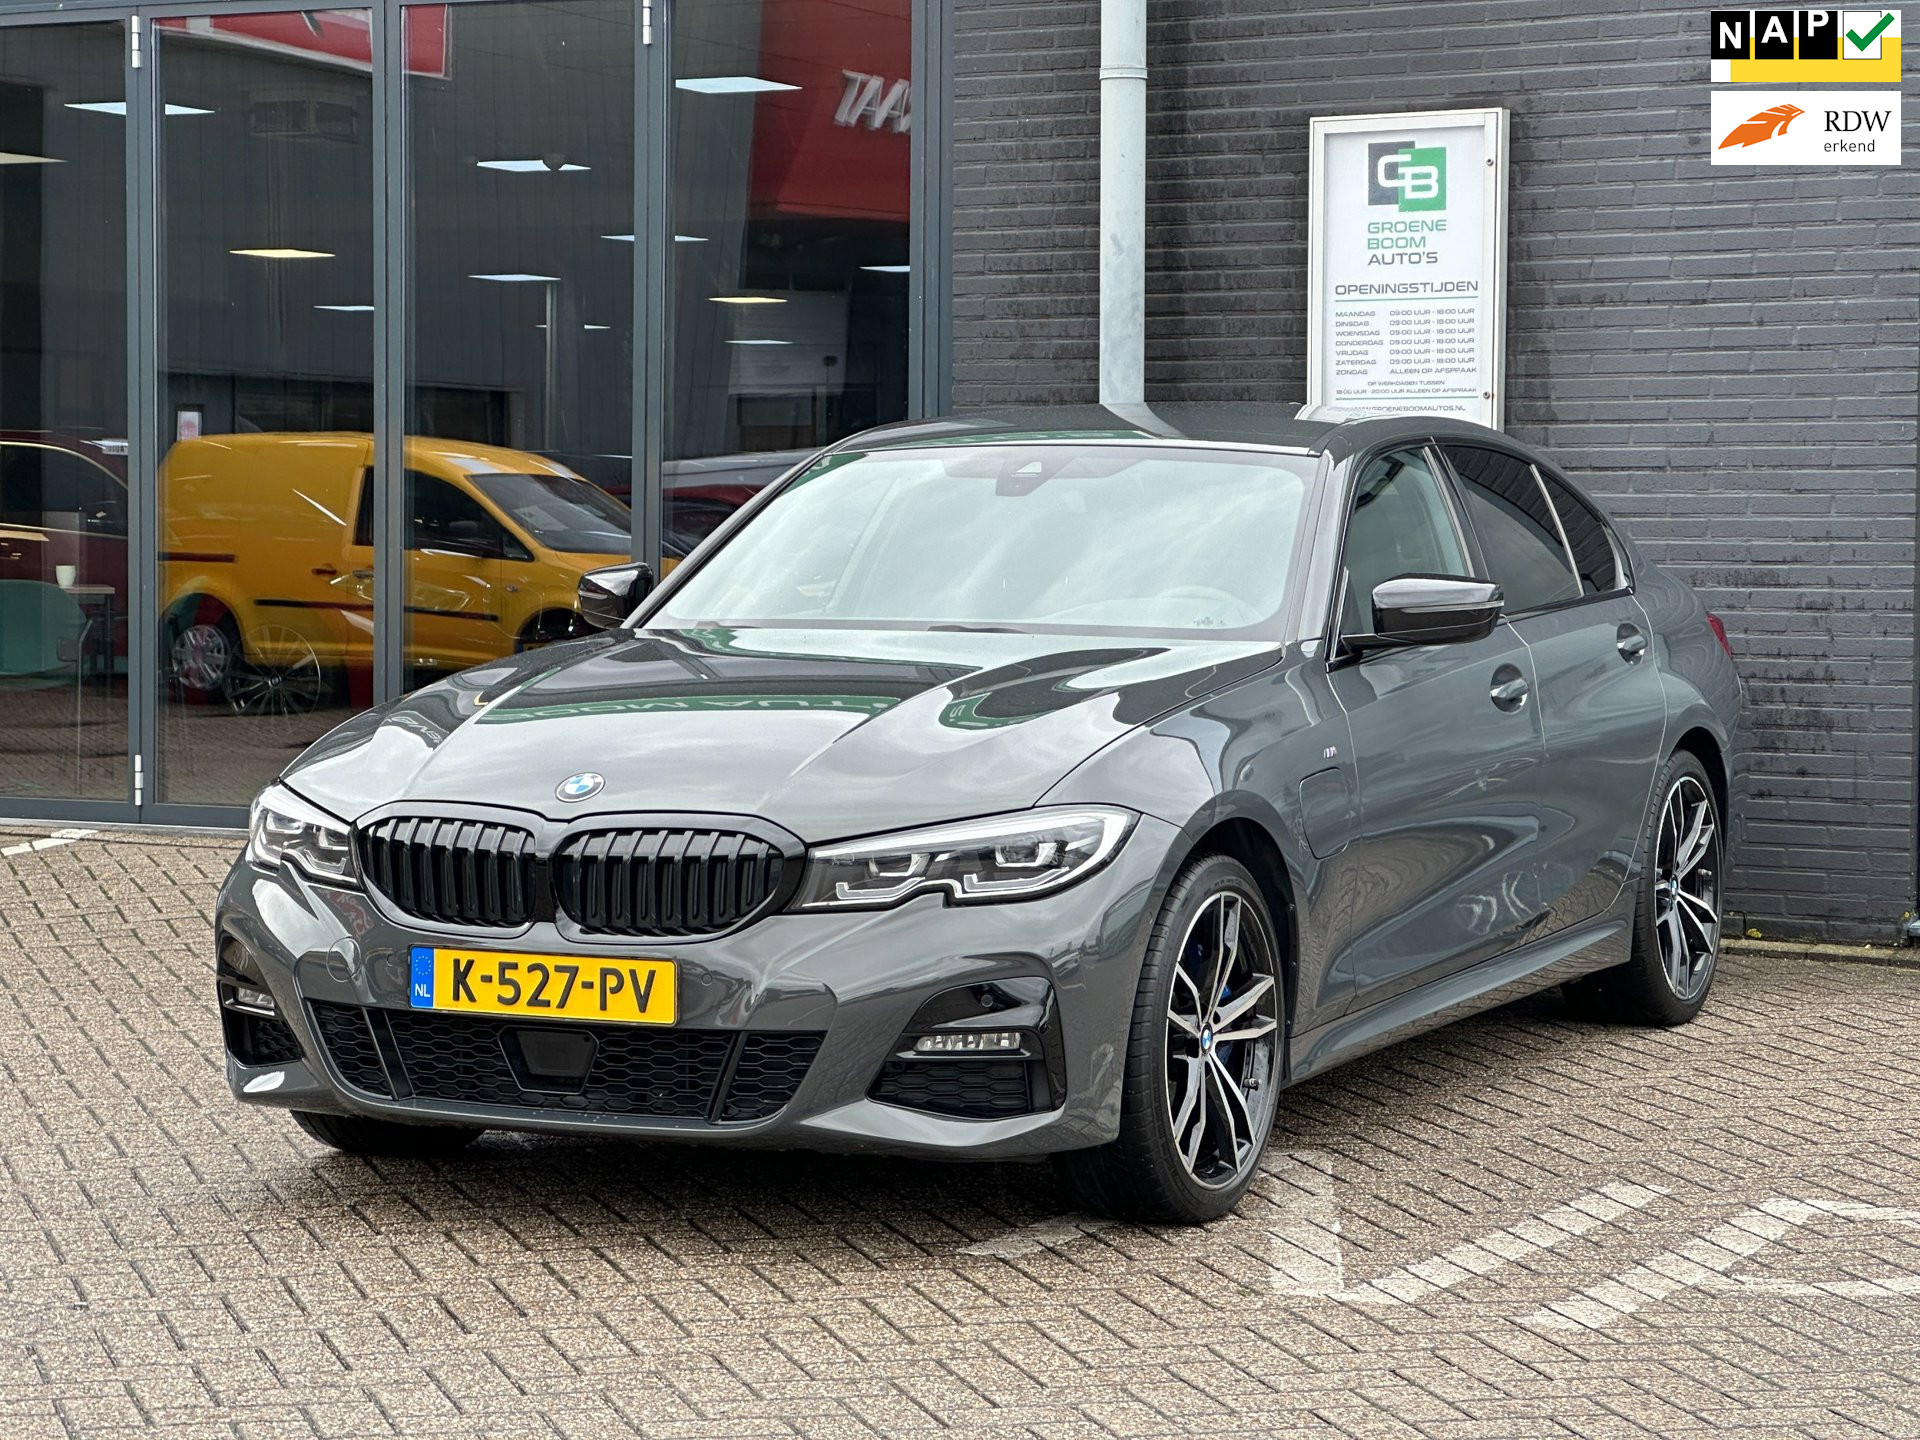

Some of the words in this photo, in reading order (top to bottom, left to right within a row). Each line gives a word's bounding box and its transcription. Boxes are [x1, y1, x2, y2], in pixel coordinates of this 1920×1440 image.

[1367, 219, 1447, 234] GROENE
[1367, 235, 1427, 250] BOOM
[1367, 251, 1438, 266] AUTO'S
[1335, 281, 1478, 295] OPENINGSTIJDEN
[414, 984, 431, 998] NL
[452, 957, 656, 1013] K-527-PV
